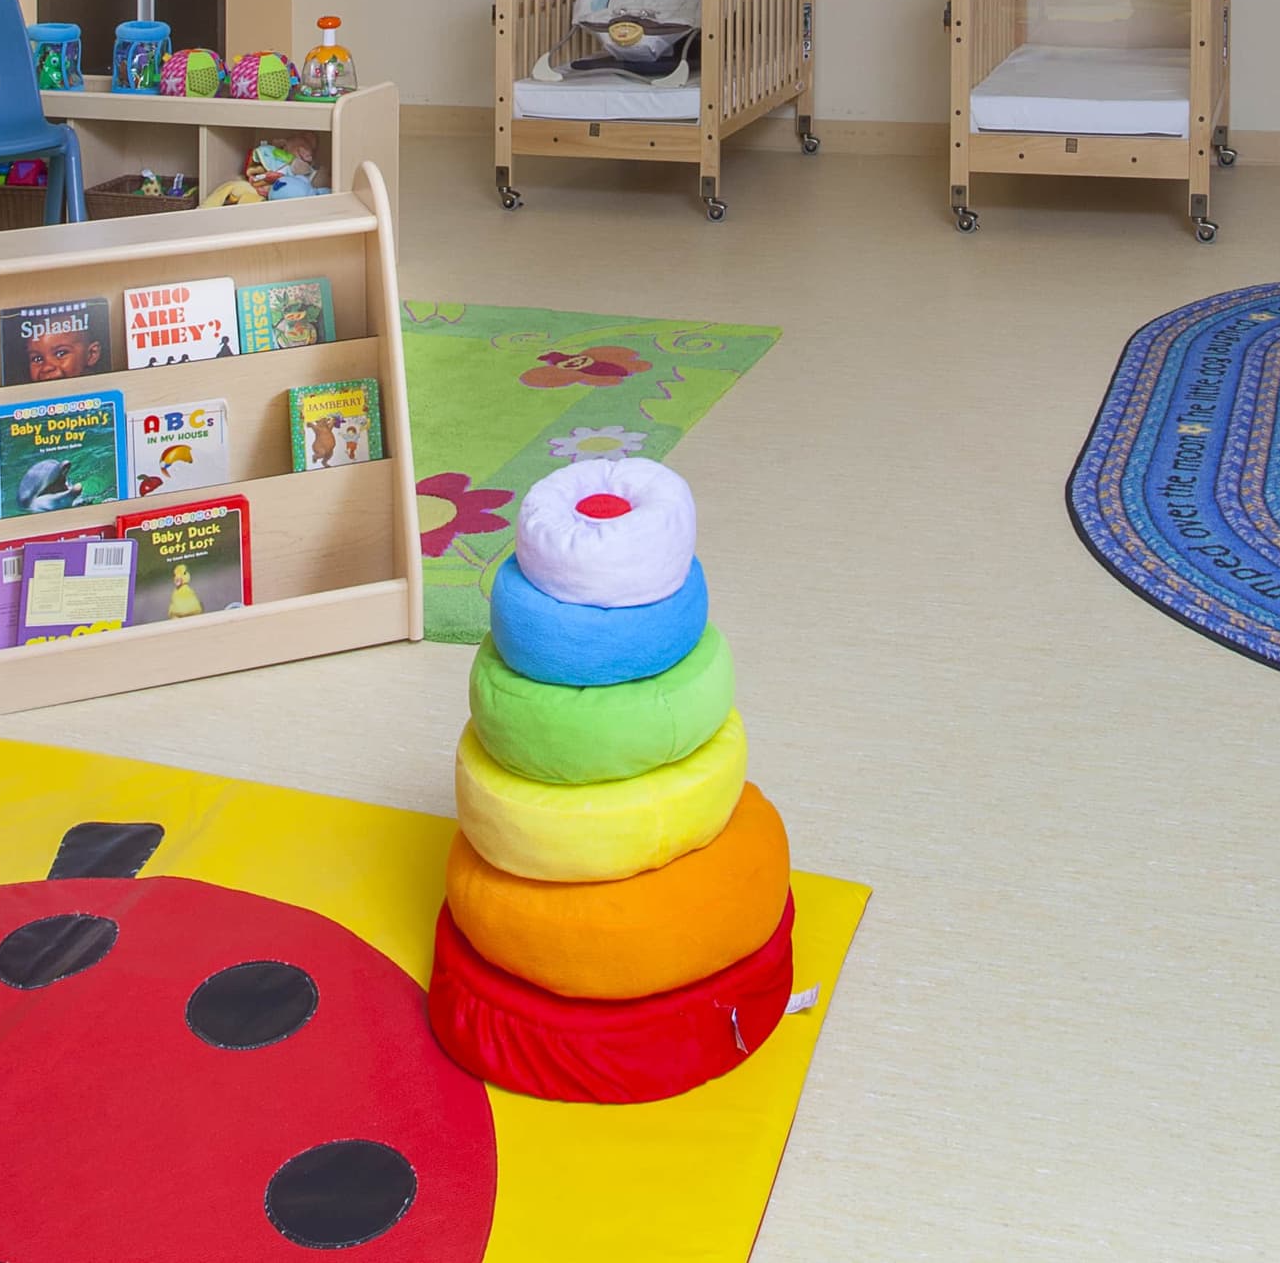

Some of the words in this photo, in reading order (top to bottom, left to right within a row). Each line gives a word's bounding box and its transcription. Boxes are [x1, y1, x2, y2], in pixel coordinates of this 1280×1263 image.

[129, 287, 191, 309] WHO
[20, 314, 89, 342] Splash!
[131, 307, 185, 330] ARE
[1196, 356, 1233, 379] dog
[1183, 378, 1224, 402] little
[307, 396, 362, 412] JAMBERRY
[1176, 403, 1217, 424] The
[10, 422, 42, 436] Baby
[47, 411, 109, 432] Dolphin's
[34, 434, 61, 446] Busy
[65, 431, 86, 441] Day
[161, 434, 174, 442] MY
[178, 430, 209, 441] HOUSE
[1172, 435, 1207, 472] moon
[1156, 474, 1198, 499] the
[1167, 502, 1211, 539] over
[152, 531, 183, 545] Baby
[188, 524, 221, 538] Duck
[159, 542, 186, 555] Gets
[189, 537, 215, 550] Lost
